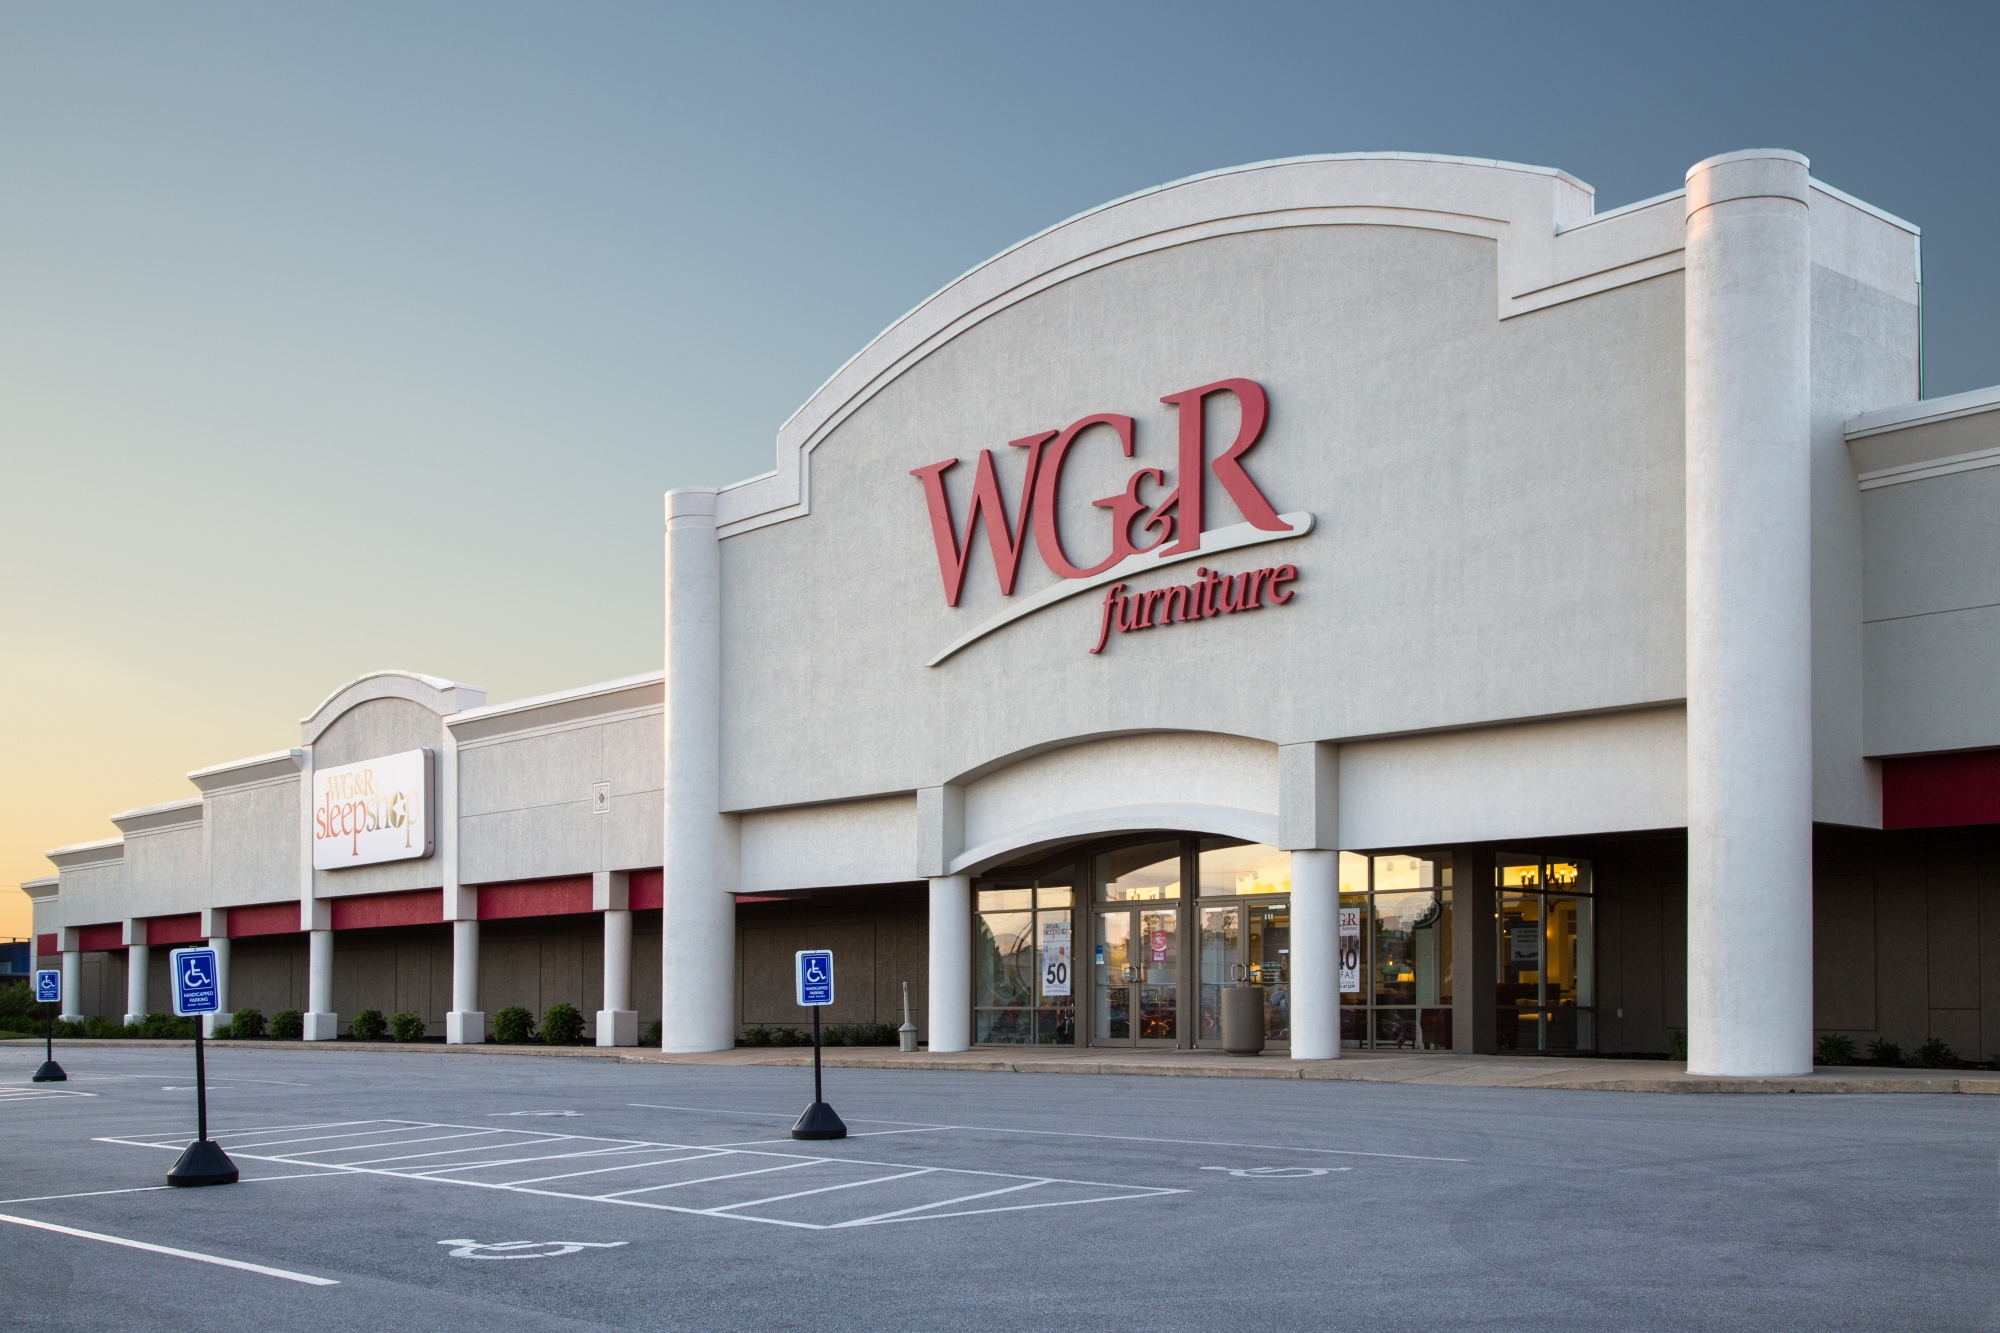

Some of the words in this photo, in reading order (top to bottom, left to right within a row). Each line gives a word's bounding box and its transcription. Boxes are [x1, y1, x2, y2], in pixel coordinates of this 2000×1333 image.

[909, 377, 1294, 607] WG&R
[1089, 563, 1299, 655] furniture
[327, 769, 375, 801] WG&R
[1340, 912, 1358, 926] G&R
[1395, 902, 1431, 923] OPEN
[1046, 963, 1067, 985] 50
[1340, 971, 1355, 979] FAS
